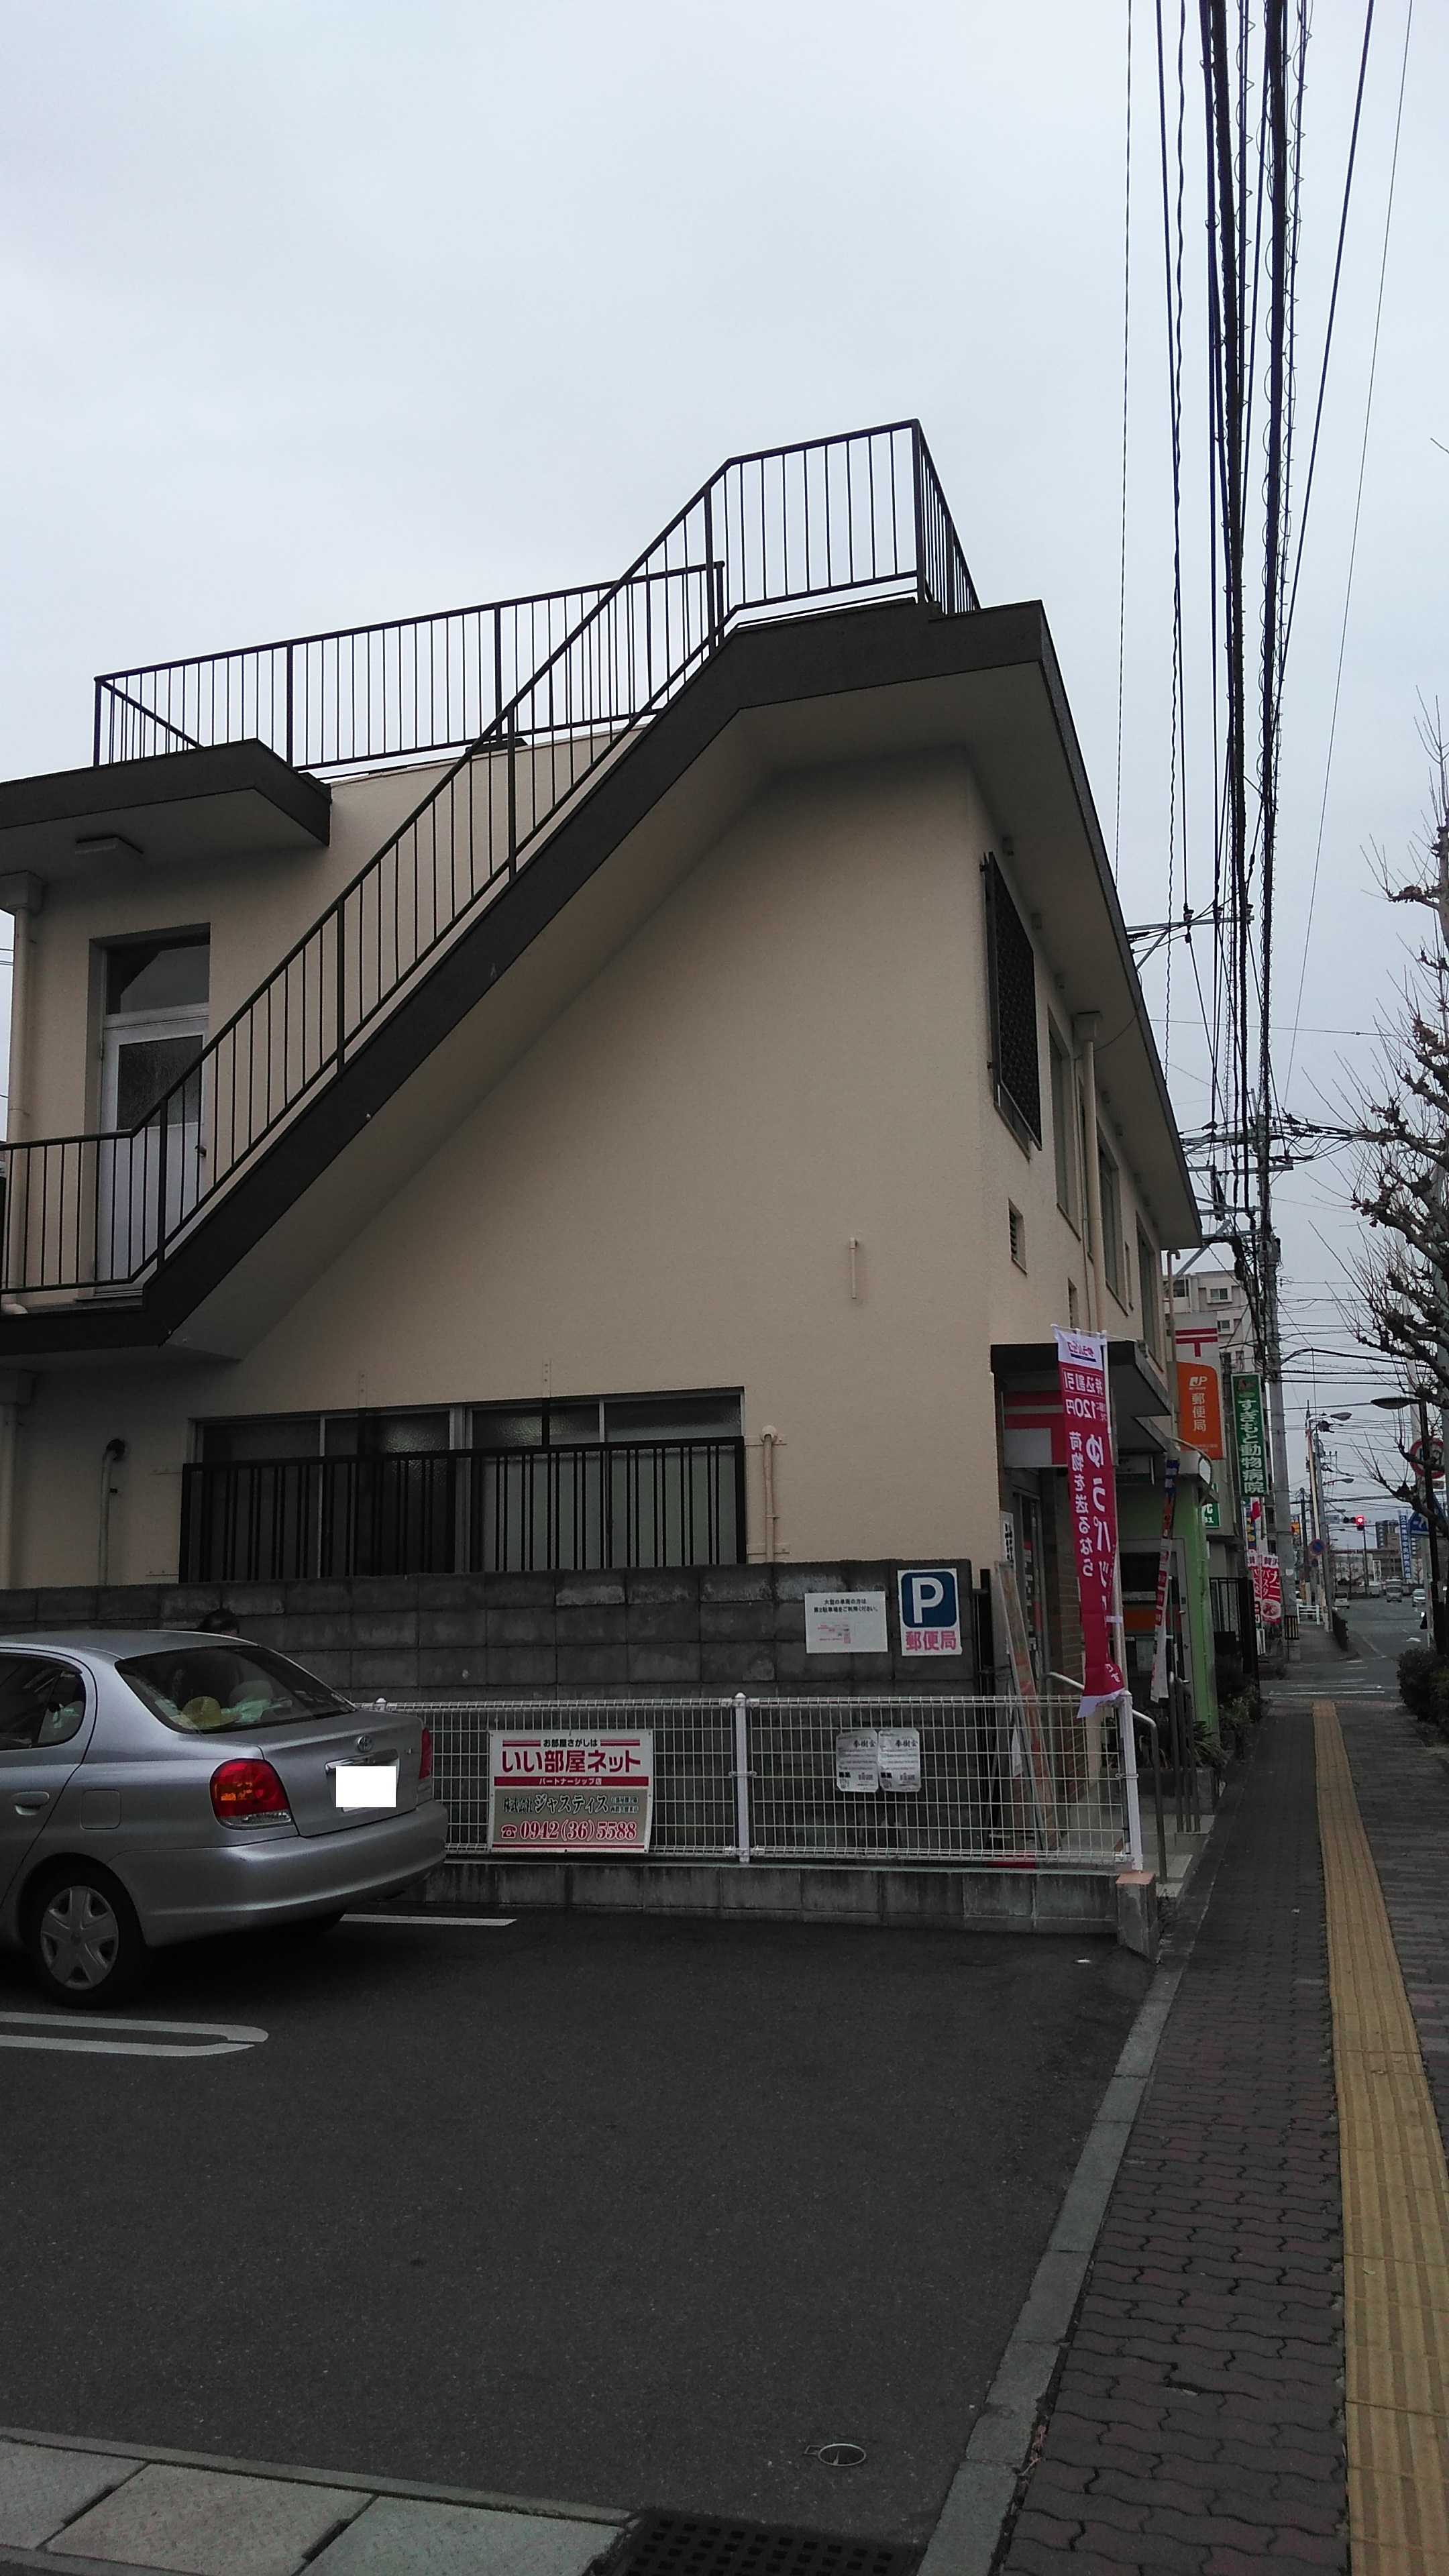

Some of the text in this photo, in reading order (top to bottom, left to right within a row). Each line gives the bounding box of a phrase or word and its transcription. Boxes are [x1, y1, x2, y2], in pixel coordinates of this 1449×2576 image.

[1191, 1393, 1207, 1432] 郵便局
[1238, 1399, 1265, 1494] すぎもと動物病院
[912, 1576, 944, 1623] P
[906, 1630, 957, 1651] 郵便局
[543, 1739, 598, 1748] お部屋さがしは
[502, 1750, 641, 1773] いい部屋ネット
[539, 1778, 602, 1786] パートナーシップ店
[519, 1819, 637, 1842] 0942(36)5588
